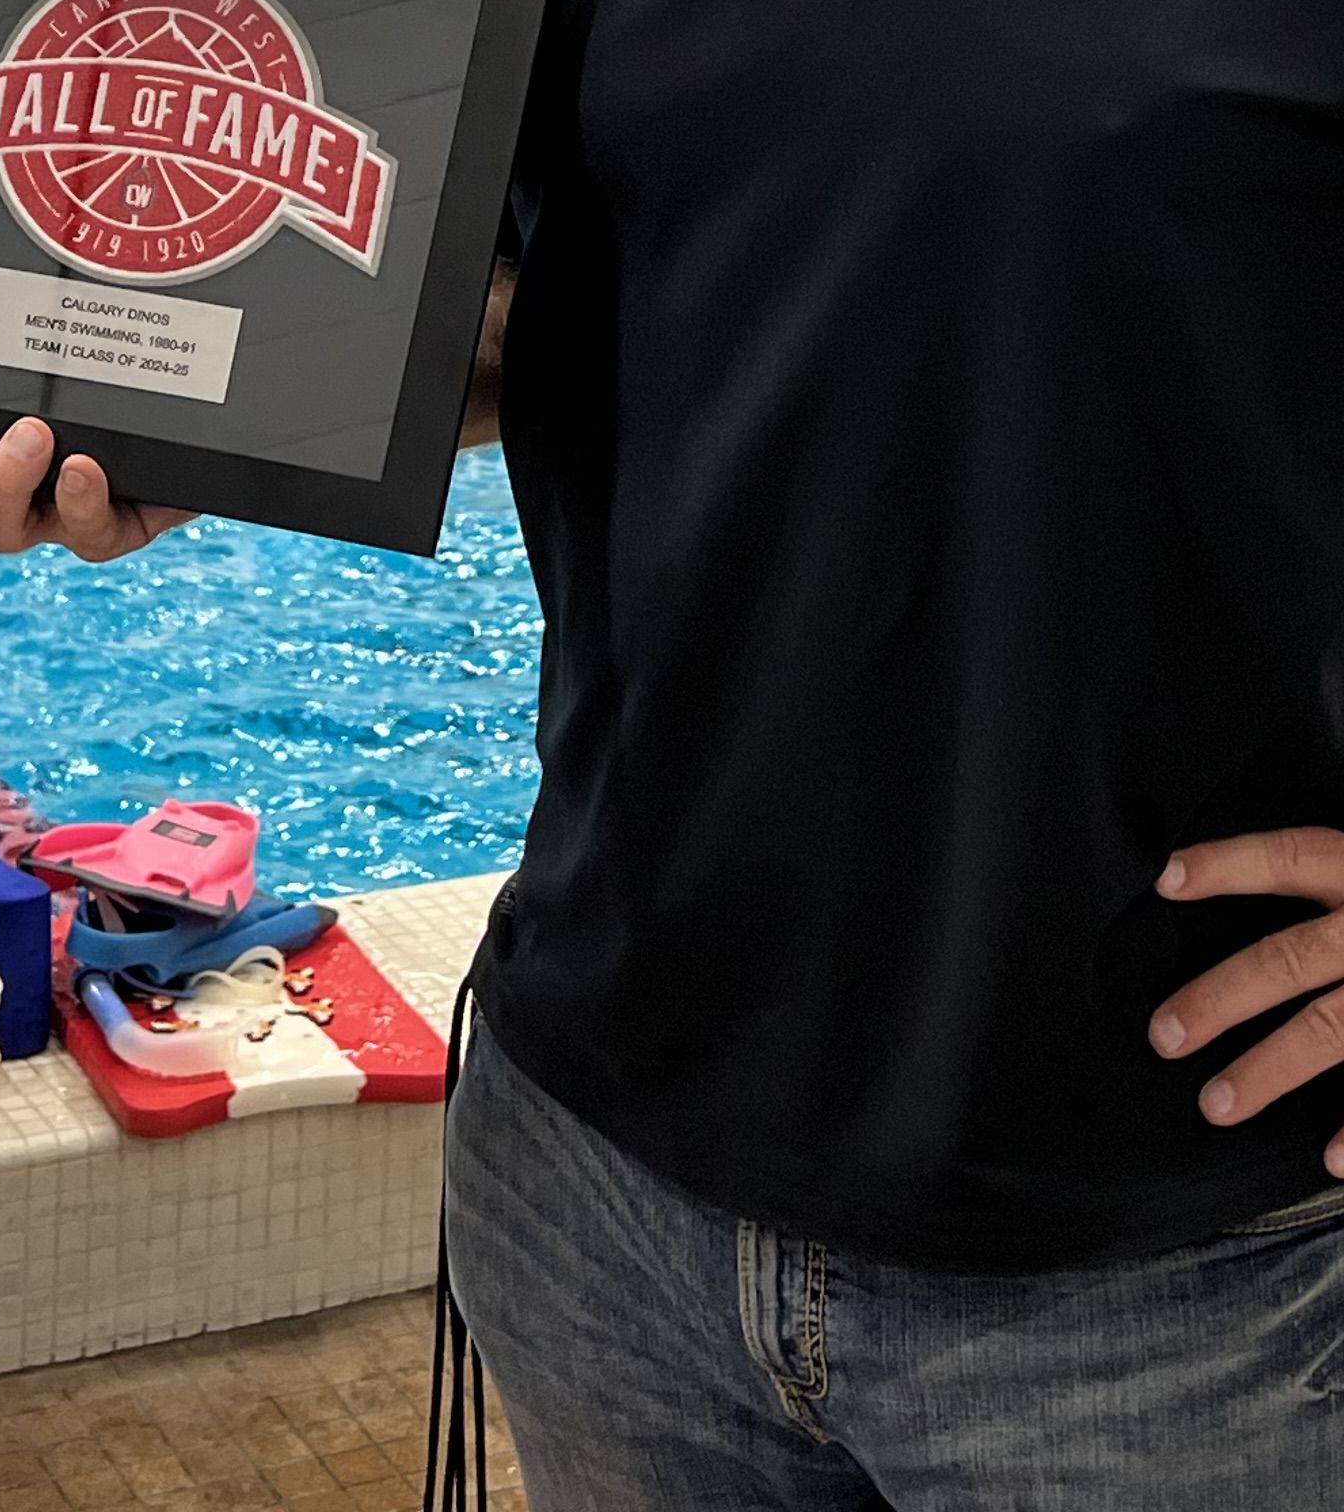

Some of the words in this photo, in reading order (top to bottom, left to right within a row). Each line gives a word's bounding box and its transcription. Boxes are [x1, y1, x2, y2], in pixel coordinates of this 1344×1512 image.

[131, 87, 179, 130] OF
[182, 84, 337, 195] FAME
[62, 297, 125, 317] CALGARY
[127, 308, 171, 326] DINOS
[25, 314, 67, 332] MEN'S
[69, 322, 143, 346] SWIMMING,
[24, 337, 61, 354] TEAM
[71, 345, 114, 363] CLASS
[117, 353, 137, 367] OF
[139, 357, 190, 376] 2024-25
